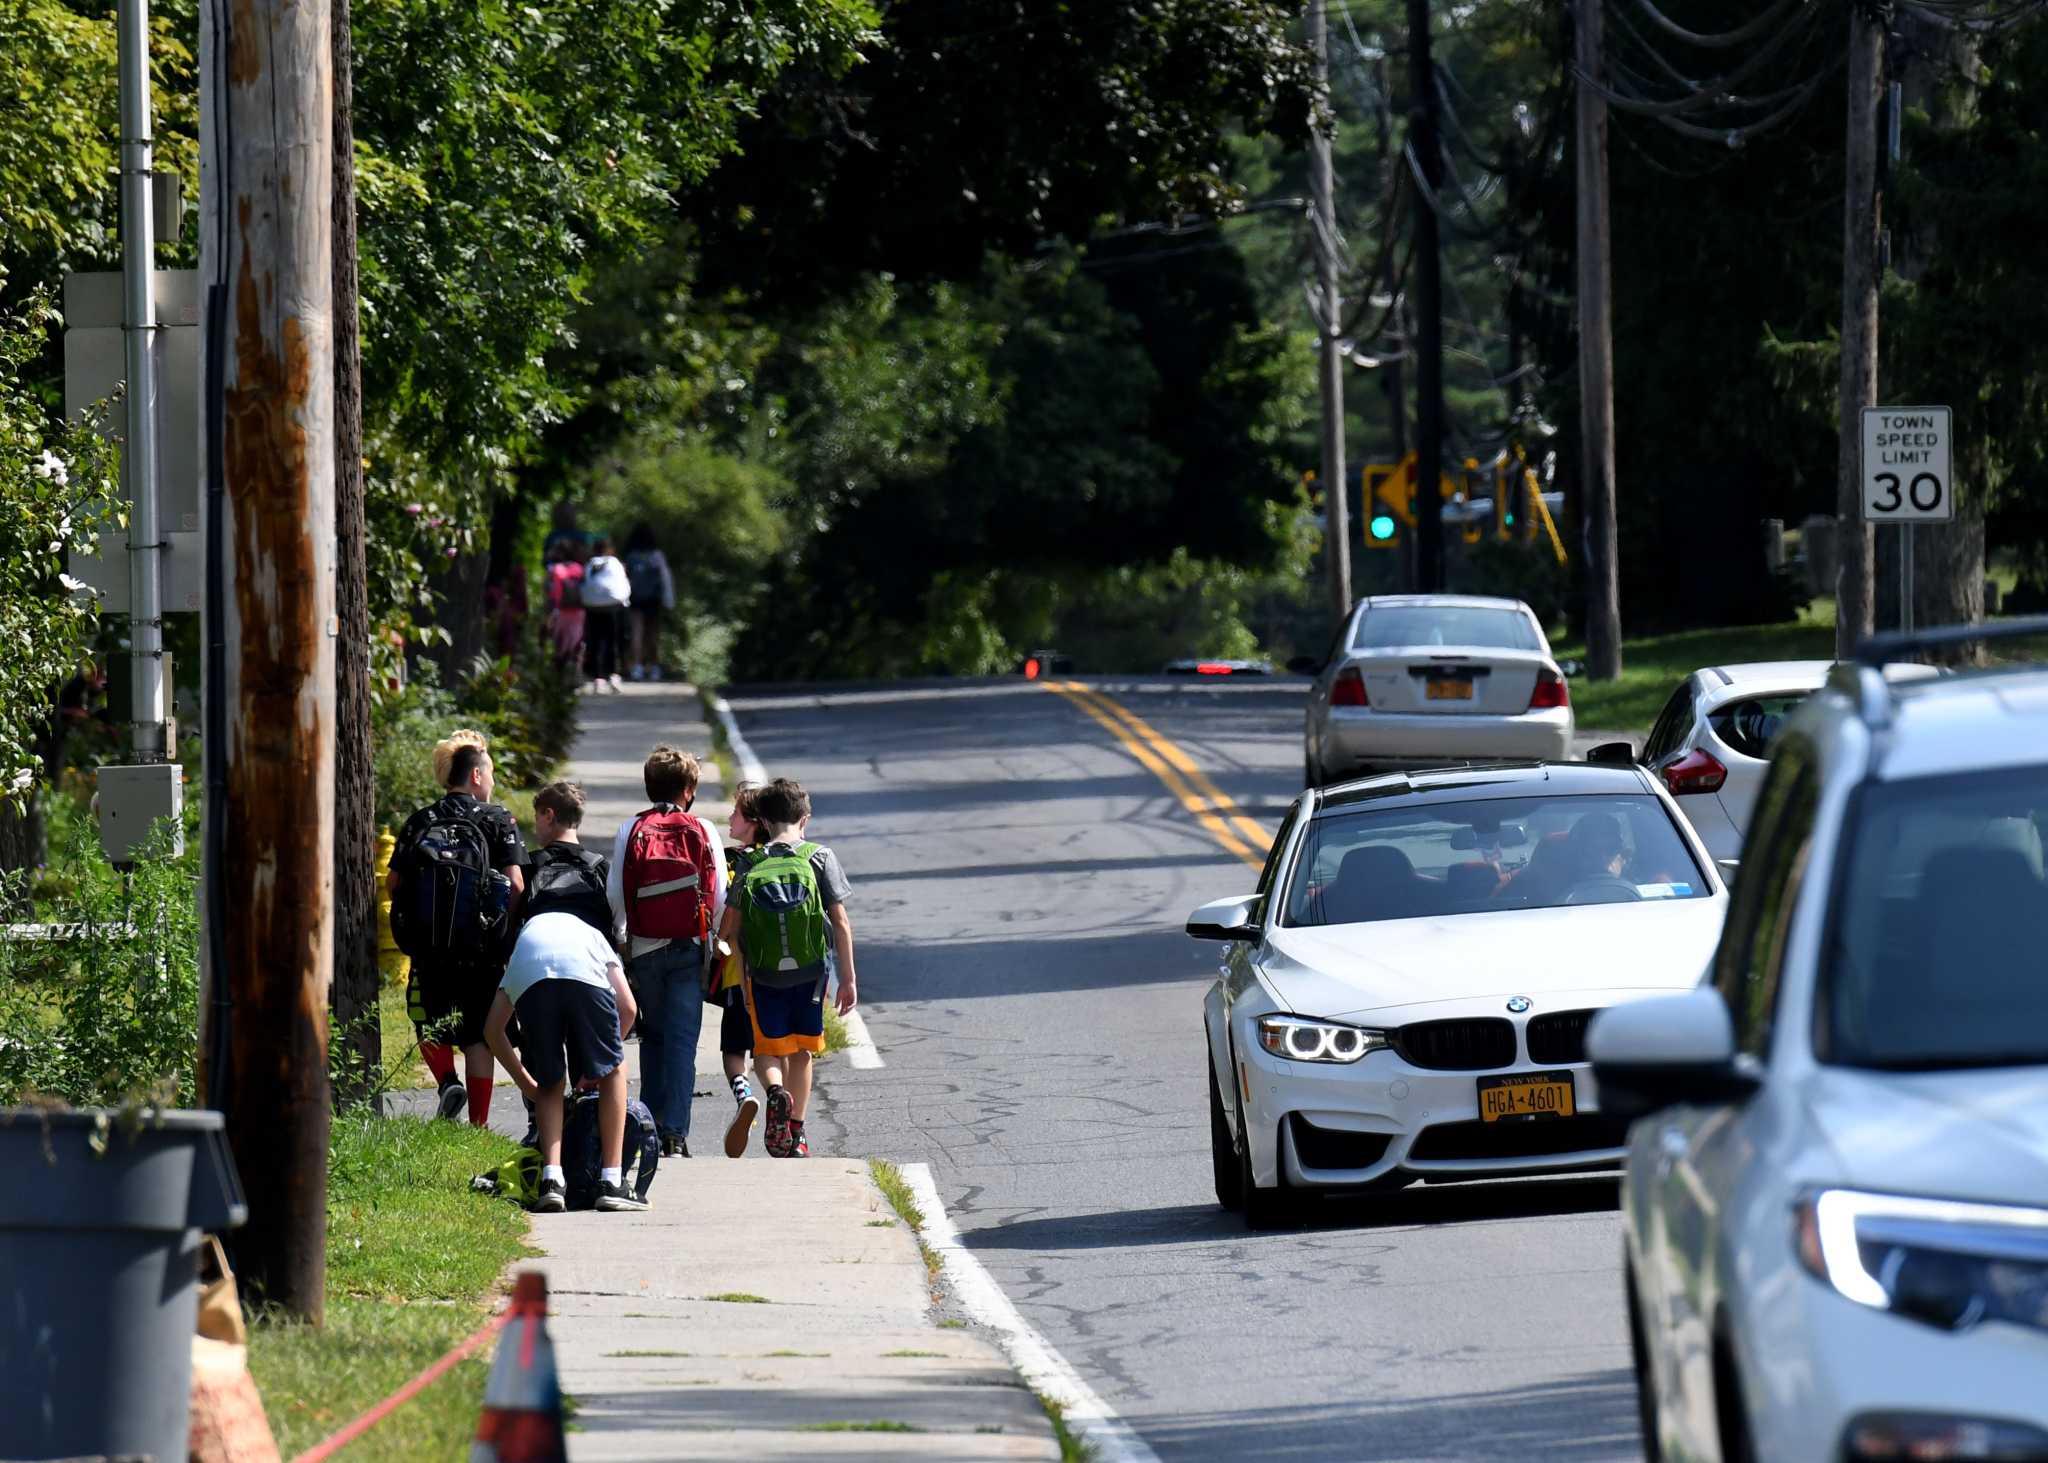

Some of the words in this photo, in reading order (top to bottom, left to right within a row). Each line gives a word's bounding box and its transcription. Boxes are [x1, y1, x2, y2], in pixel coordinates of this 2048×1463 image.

[1881, 416, 1933, 429] TOWN
[1876, 433, 1938, 447] SPEED
[1882, 451, 1931, 464] LIMIT
[1872, 472, 1942, 512] 30
